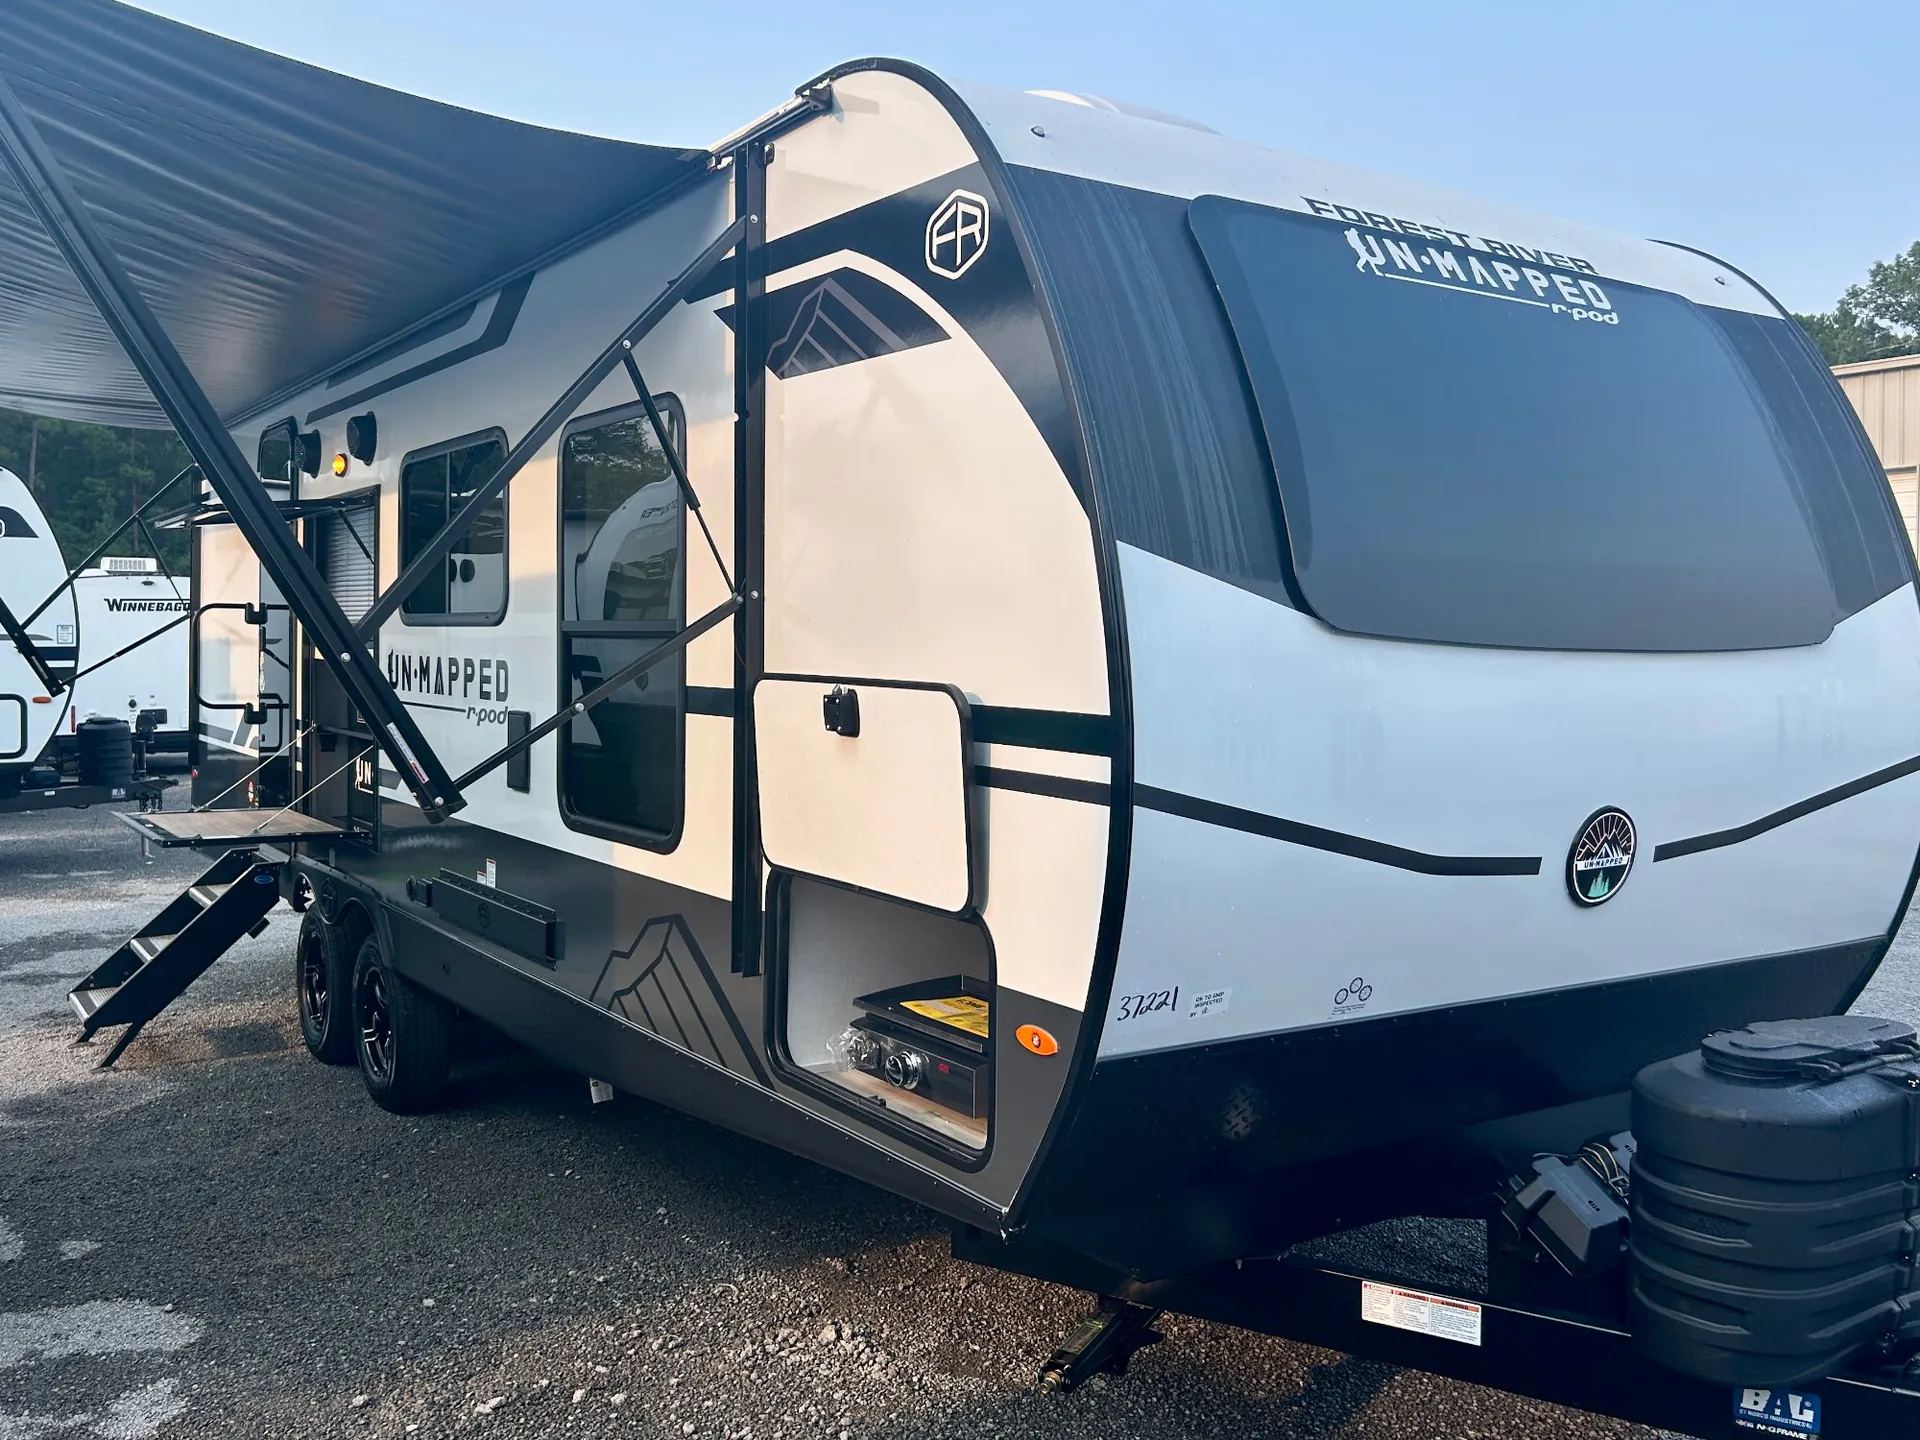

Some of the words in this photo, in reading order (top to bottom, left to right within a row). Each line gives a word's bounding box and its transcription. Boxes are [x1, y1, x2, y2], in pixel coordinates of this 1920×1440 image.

[1300, 196, 1471, 247] FOREST
[1477, 236, 1600, 275] RIVER
[1117, 986, 1178, 1021] 37221
[1194, 997, 1223, 1009] INSPECTED
[1740, 1388, 1814, 1423] BAL
[1776, 1428, 1808, 1440] FRAME
